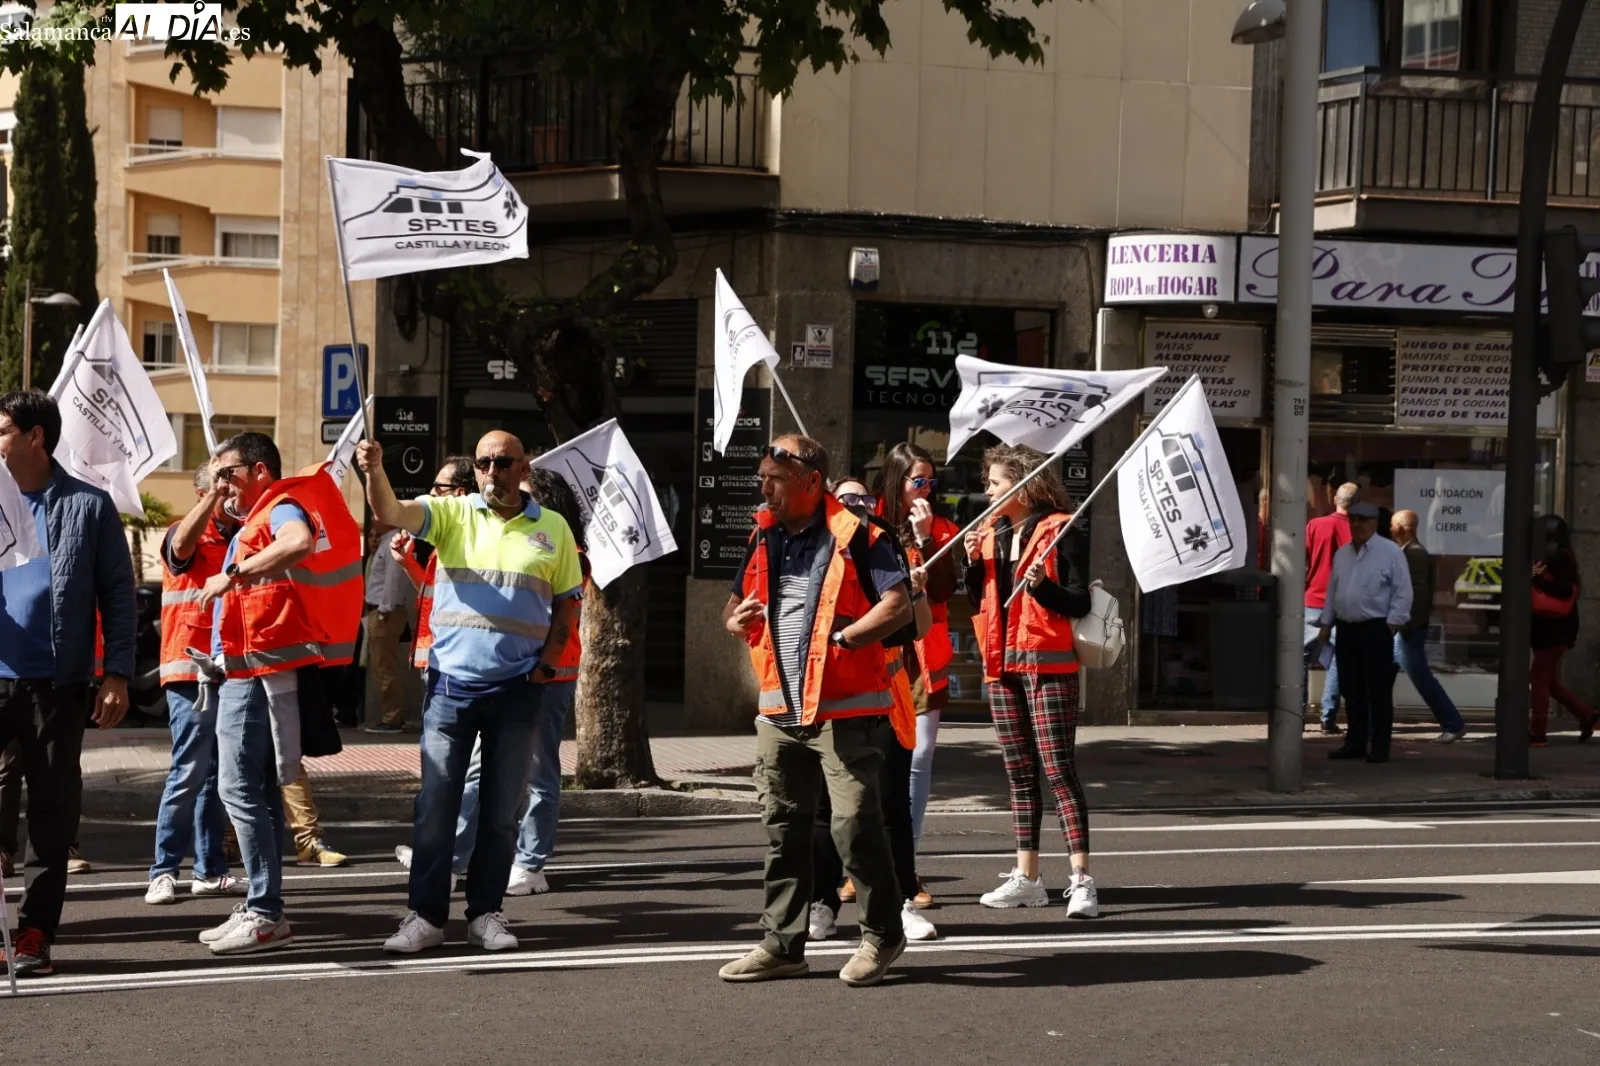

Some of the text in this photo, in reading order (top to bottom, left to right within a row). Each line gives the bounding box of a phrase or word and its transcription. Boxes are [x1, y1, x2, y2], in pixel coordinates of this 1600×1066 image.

[408, 218, 498, 234] SP-TES
[395, 240, 459, 250] CASTILLA
[462, 240, 474, 250] Y
[1111, 243, 1217, 264] LENCERIA
[1110, 276, 1218, 296] ROPA DE HOGAR
[1155, 331, 1221, 341] PIJAMAS
[926, 331, 979, 355] 112
[1155, 342, 1194, 351] BATAS
[1401, 340, 1447, 349] JUEGO
[1154, 353, 1231, 362] ALBORNOZ
[1401, 352, 1450, 361] MANTAS
[1464, 354, 1511, 363] EDREDO
[1401, 364, 1481, 373] PROTECTOR
[330, 352, 356, 410] P
[1400, 375, 1440, 384] FUNDA
[1444, 376, 1460, 385] DE
[1401, 386, 1448, 395] FUNDA
[1453, 388, 1471, 396] DE
[1400, 396, 1507, 408] PAÑOS DE COCINA
[1400, 409, 1446, 417] JUEGO
[1451, 411, 1469, 419] DE
[1149, 459, 1182, 524] SP-TES
[1420, 487, 1483, 499] LIQUIDACIÓN
[586, 485, 618, 533] SP-TES
[1441, 505, 1462, 516] POR
[1145, 510, 1163, 539] LEÓN
[1435, 522, 1468, 532] CIERRE
